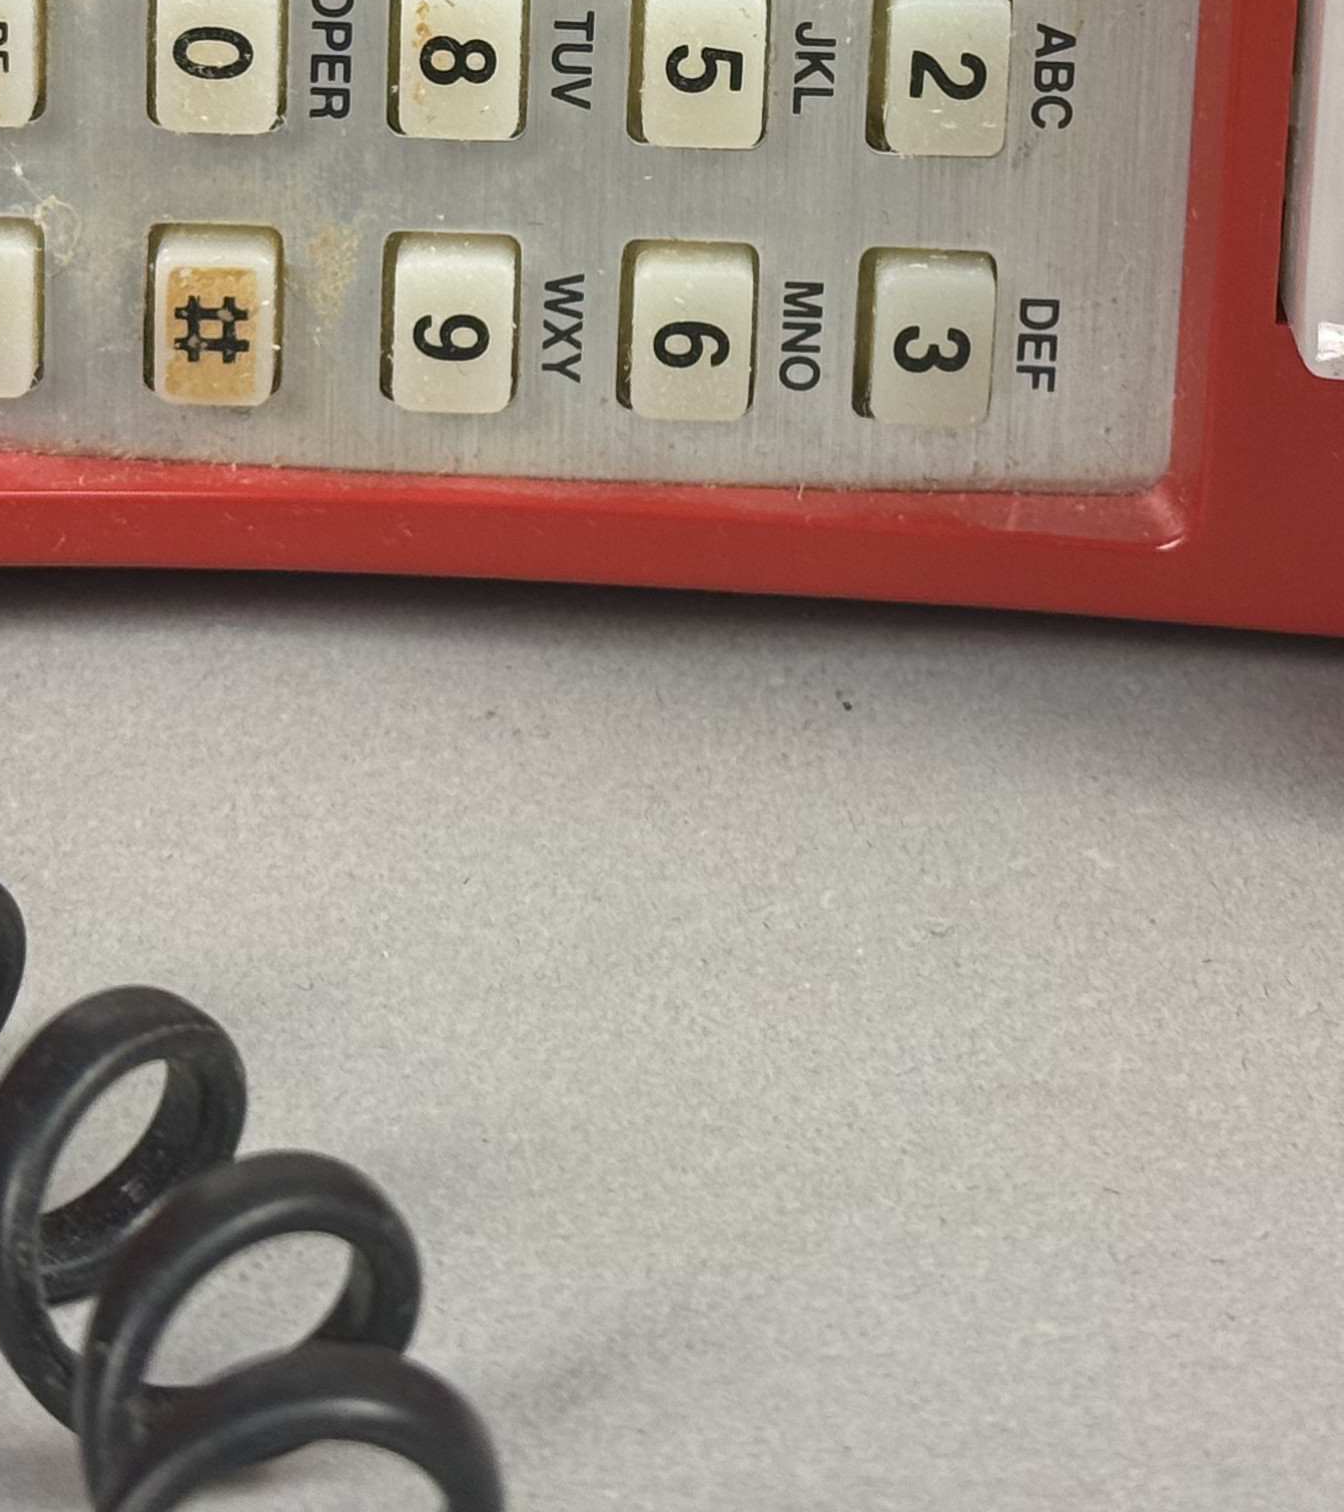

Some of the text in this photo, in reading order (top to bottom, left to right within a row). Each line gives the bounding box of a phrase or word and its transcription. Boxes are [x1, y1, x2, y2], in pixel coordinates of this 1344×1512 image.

[172, 26, 254, 81] 0
[419, 35, 498, 86] 8
[549, 10, 595, 111] TUV
[664, 44, 744, 94] 5
[792, 21, 837, 115] JKL
[909, 50, 988, 101] 2
[1030, 22, 1077, 130] ABC
[173, 295, 249, 364] #
[411, 313, 491, 363] 9
[541, 274, 586, 384] WXY
[652, 321, 731, 369] 6
[778, 281, 824, 393] MNO
[893, 325, 972, 374] 3
[1016, 298, 1061, 394] DEF
